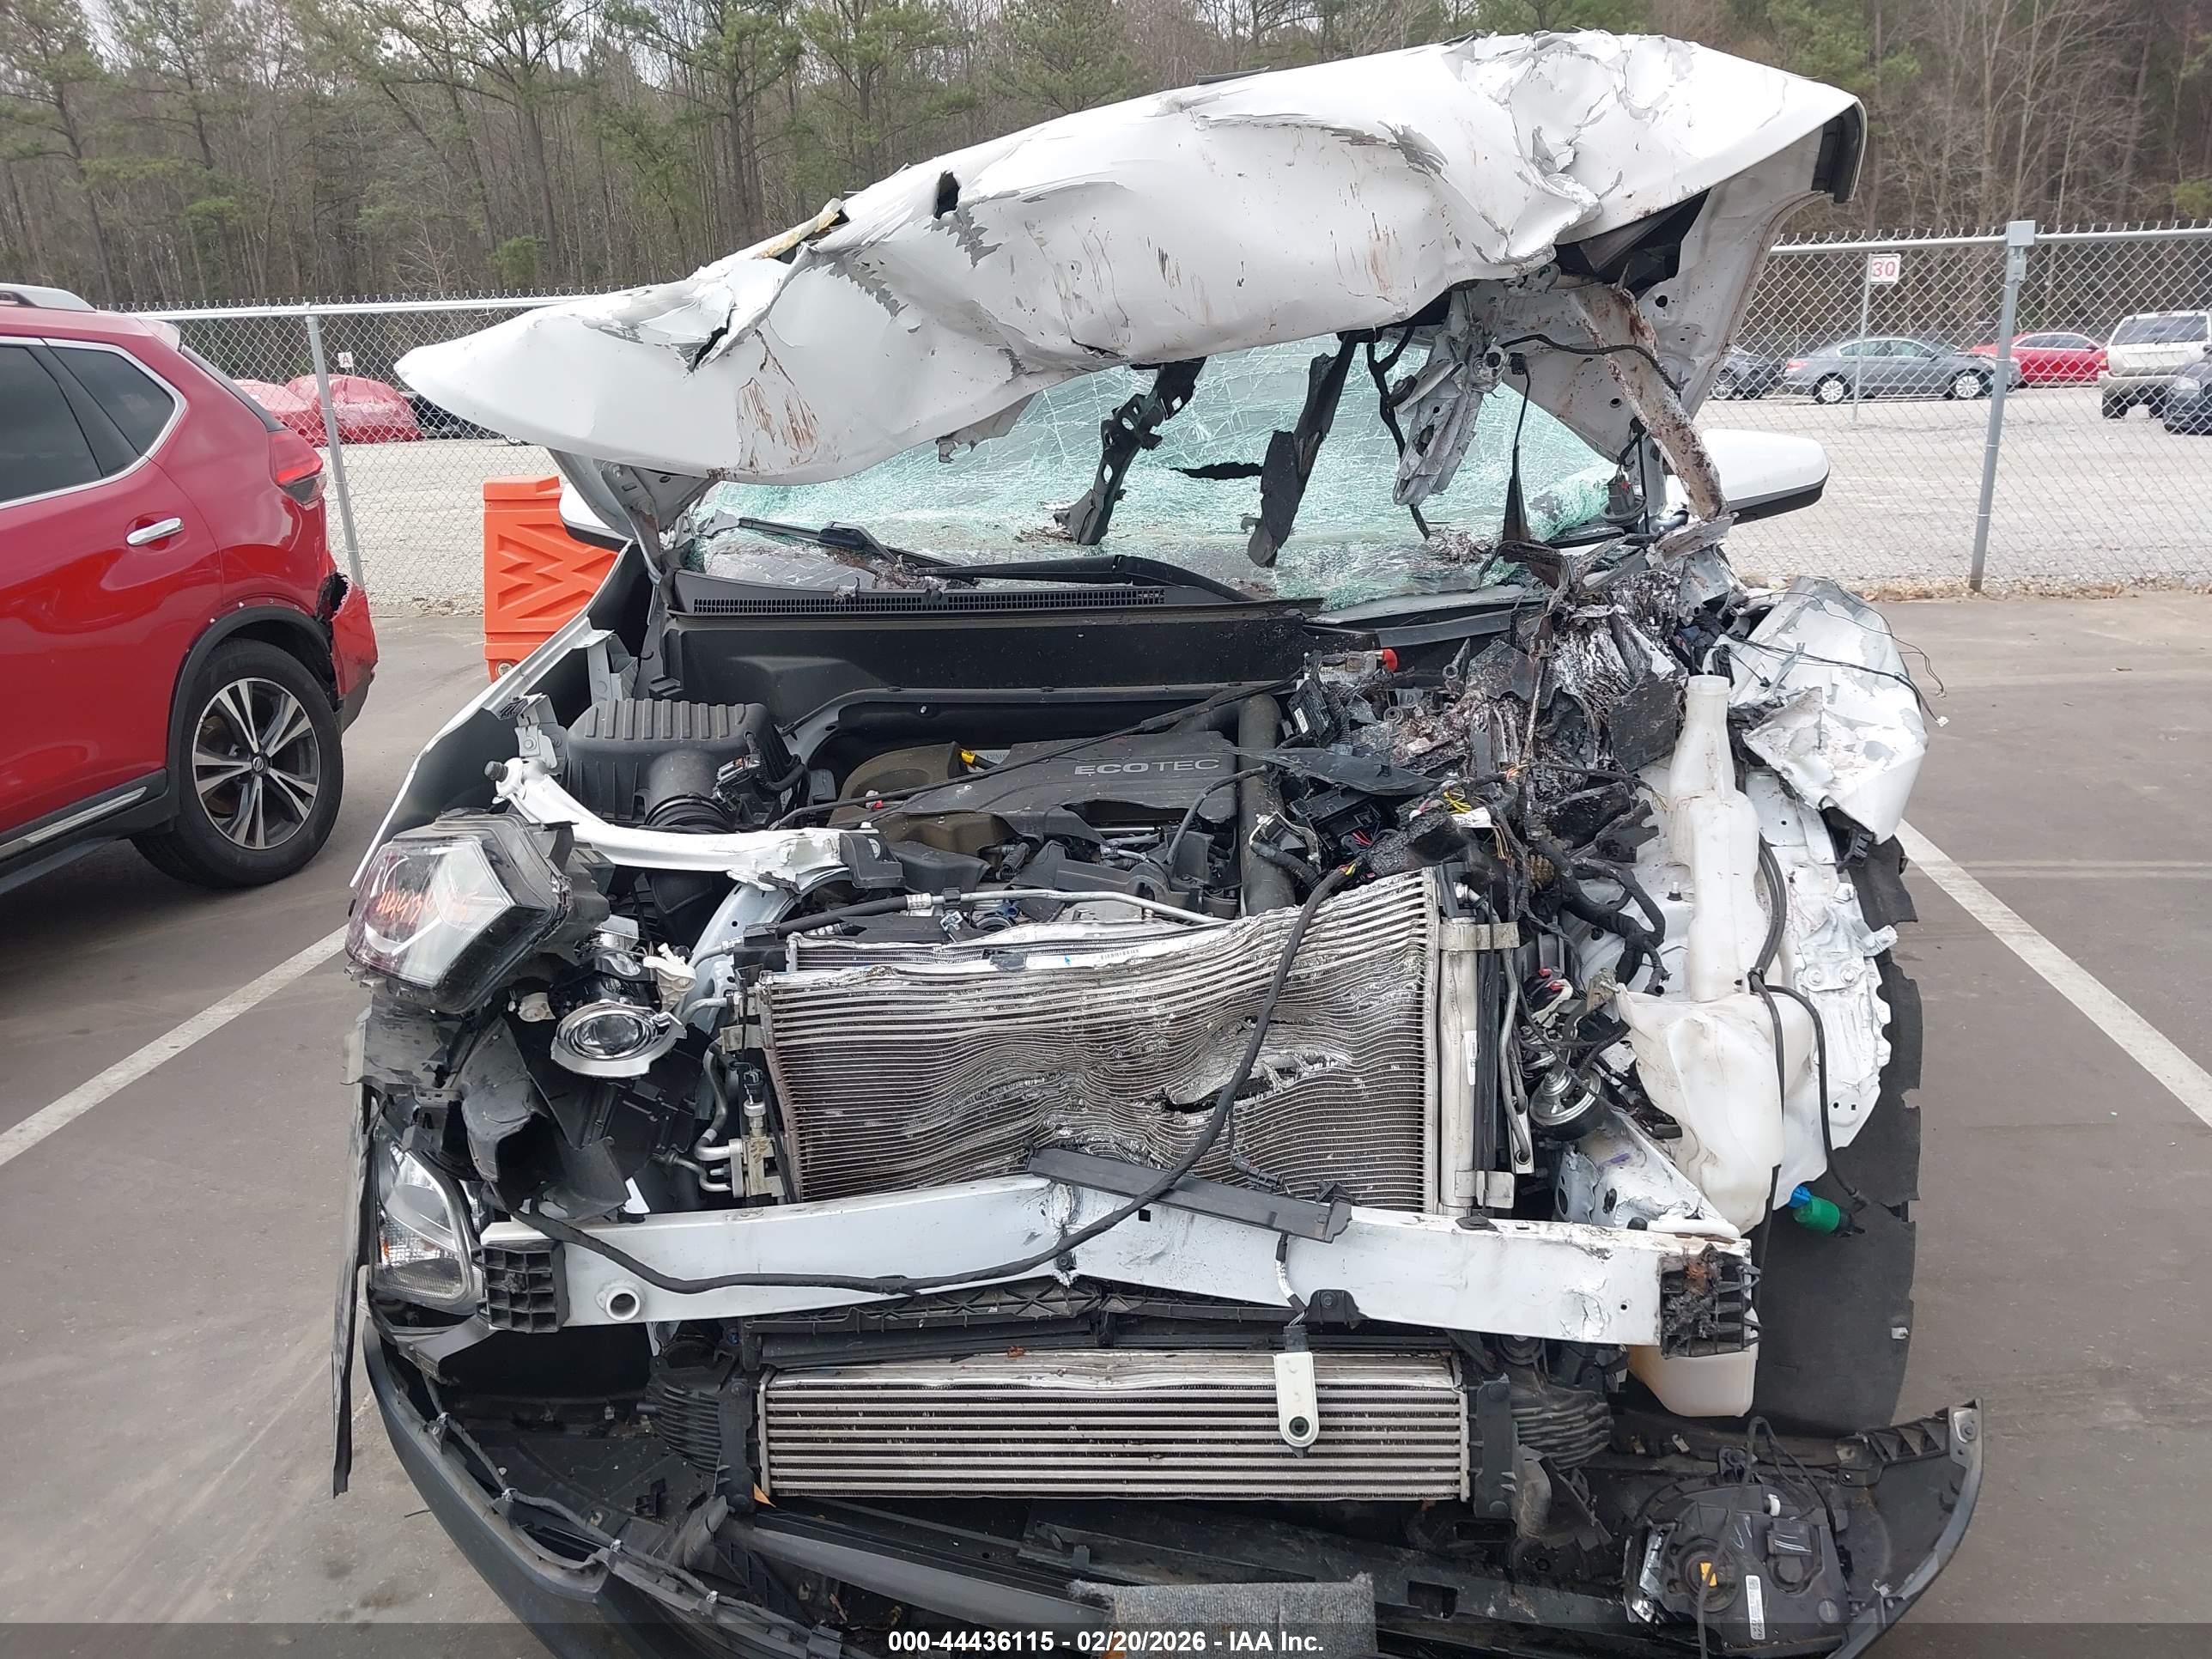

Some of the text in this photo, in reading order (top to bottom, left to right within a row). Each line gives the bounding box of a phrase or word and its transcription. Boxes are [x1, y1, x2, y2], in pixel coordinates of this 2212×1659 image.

[1873, 261, 1896, 276] 30
[342, 353, 351, 364] A
[1074, 759, 1219, 775] ECOTEC
